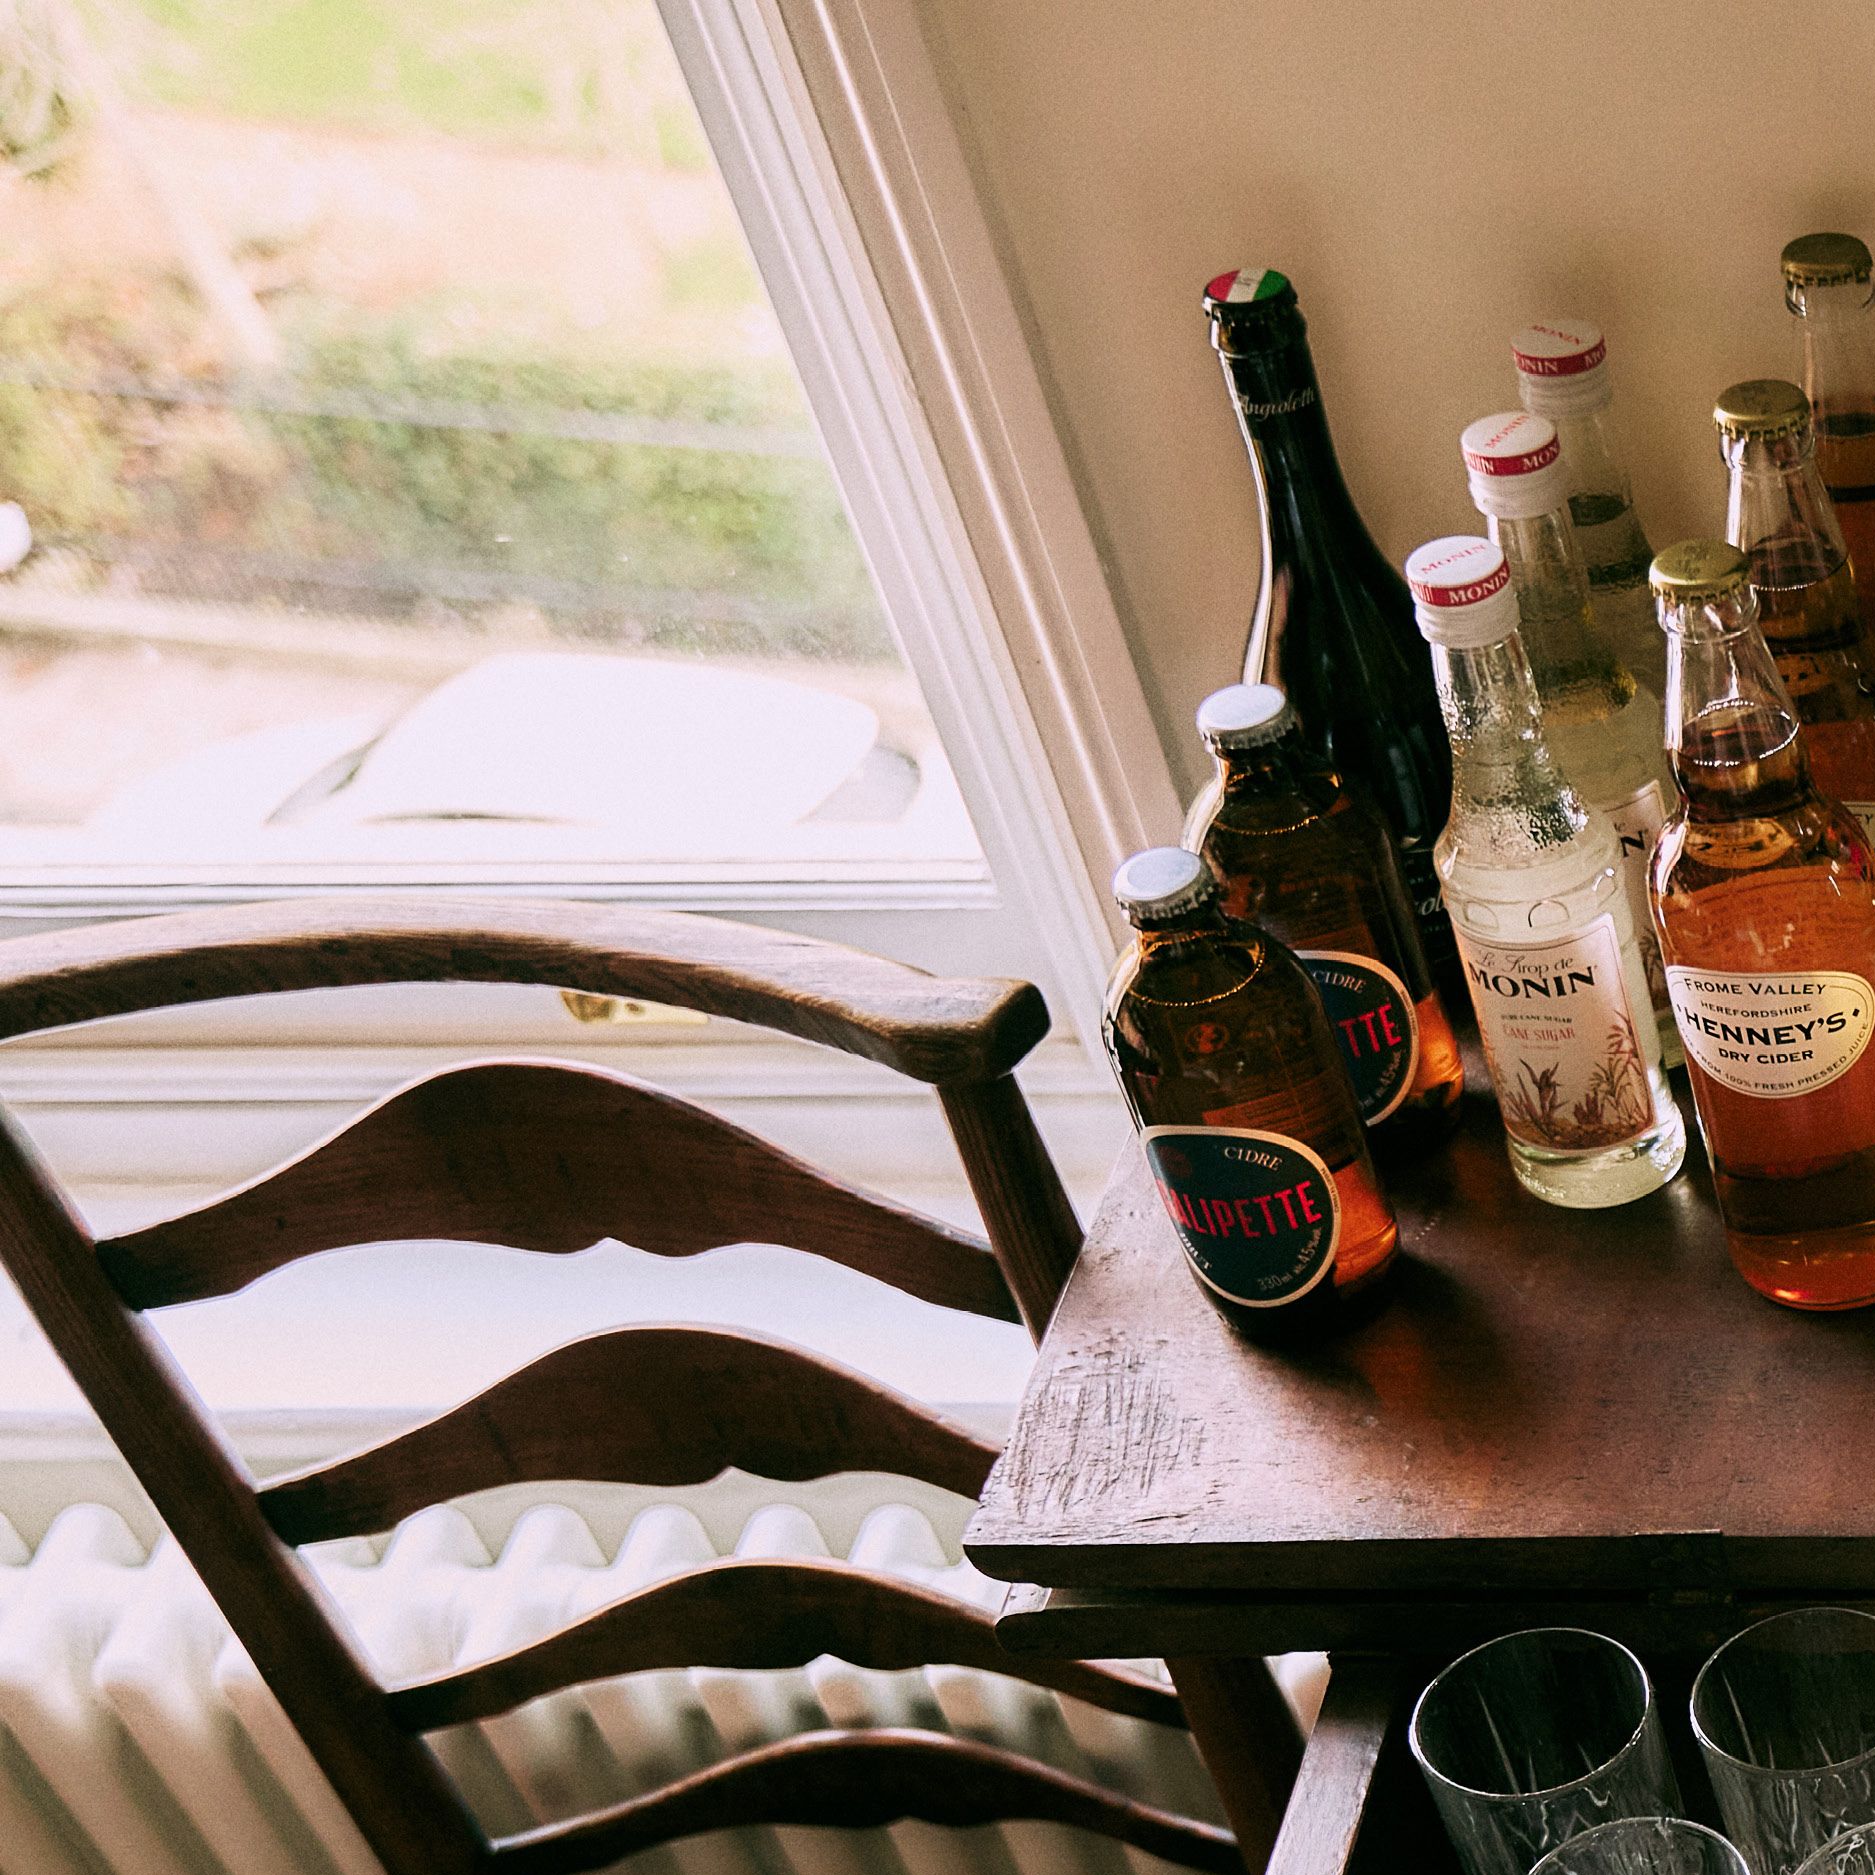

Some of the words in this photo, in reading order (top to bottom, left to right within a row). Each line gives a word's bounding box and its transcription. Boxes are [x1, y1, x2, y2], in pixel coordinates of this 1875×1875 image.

[1485, 414, 1529, 449] MONIN
[1523, 441, 1560, 471] MON
[1420, 543, 1487, 575] MONIN
[1448, 567, 1509, 605] MONIN
[1476, 951, 1496, 969] Le
[1502, 954, 1550, 979] Sirop
[1554, 957, 1574, 970] de
[1312, 969, 1367, 994] CIDRE
[1468, 961, 1596, 999] MONIN
[1684, 978, 1743, 995] FROME
[1748, 983, 1827, 995] VALLEY
[1544, 1015, 1573, 1024] SUGAR
[1700, 1000, 1813, 1018] HEREFORDSHIRE
[1503, 1026, 1530, 1041] CANE
[1534, 1026, 1576, 1042] SUGAR
[1684, 1006, 1847, 1046] HENNEY'S
[1718, 1047, 1750, 1063] DRY
[1756, 1049, 1814, 1065] CIDER
[1754, 1081, 1795, 1091] FRESH
[1797, 1055, 1848, 1087] PRESSED
[1849, 1022, 1869, 1056] JUICE
[1224, 1147, 1283, 1171] CIDRE
